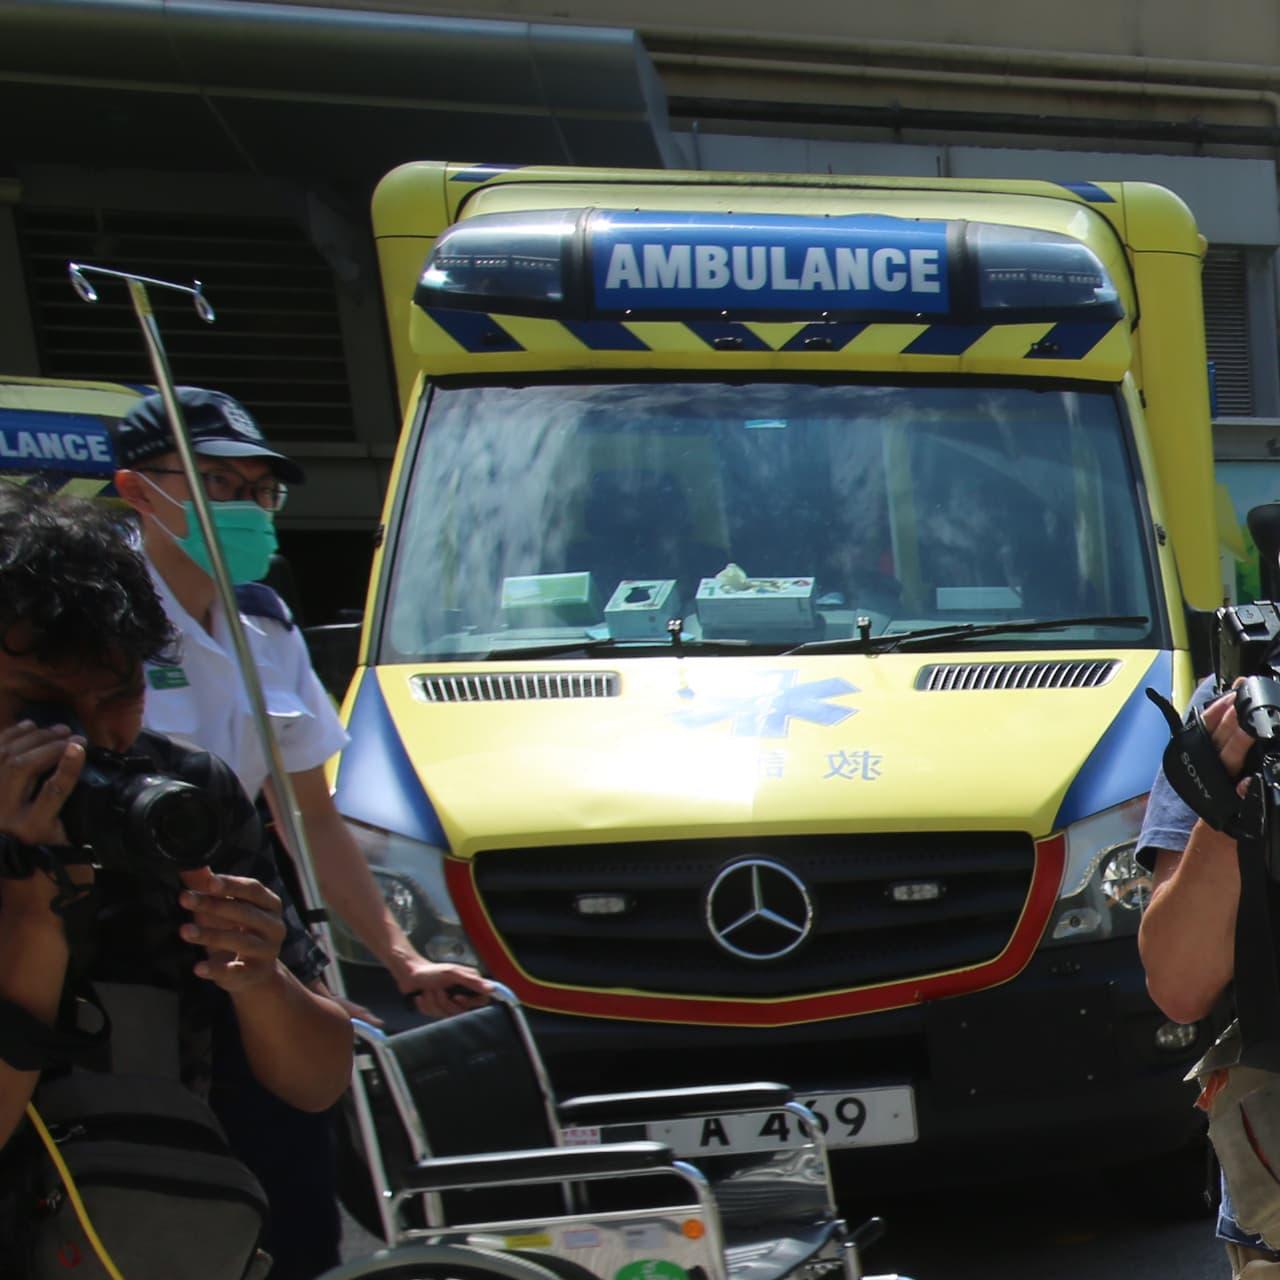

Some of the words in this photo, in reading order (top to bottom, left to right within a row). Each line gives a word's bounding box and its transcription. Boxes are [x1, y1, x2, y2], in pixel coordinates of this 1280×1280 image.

[604, 243, 941, 293] AMBULANCE
[1183, 751, 1211, 799] SONY
[700, 1117, 730, 1147] A
